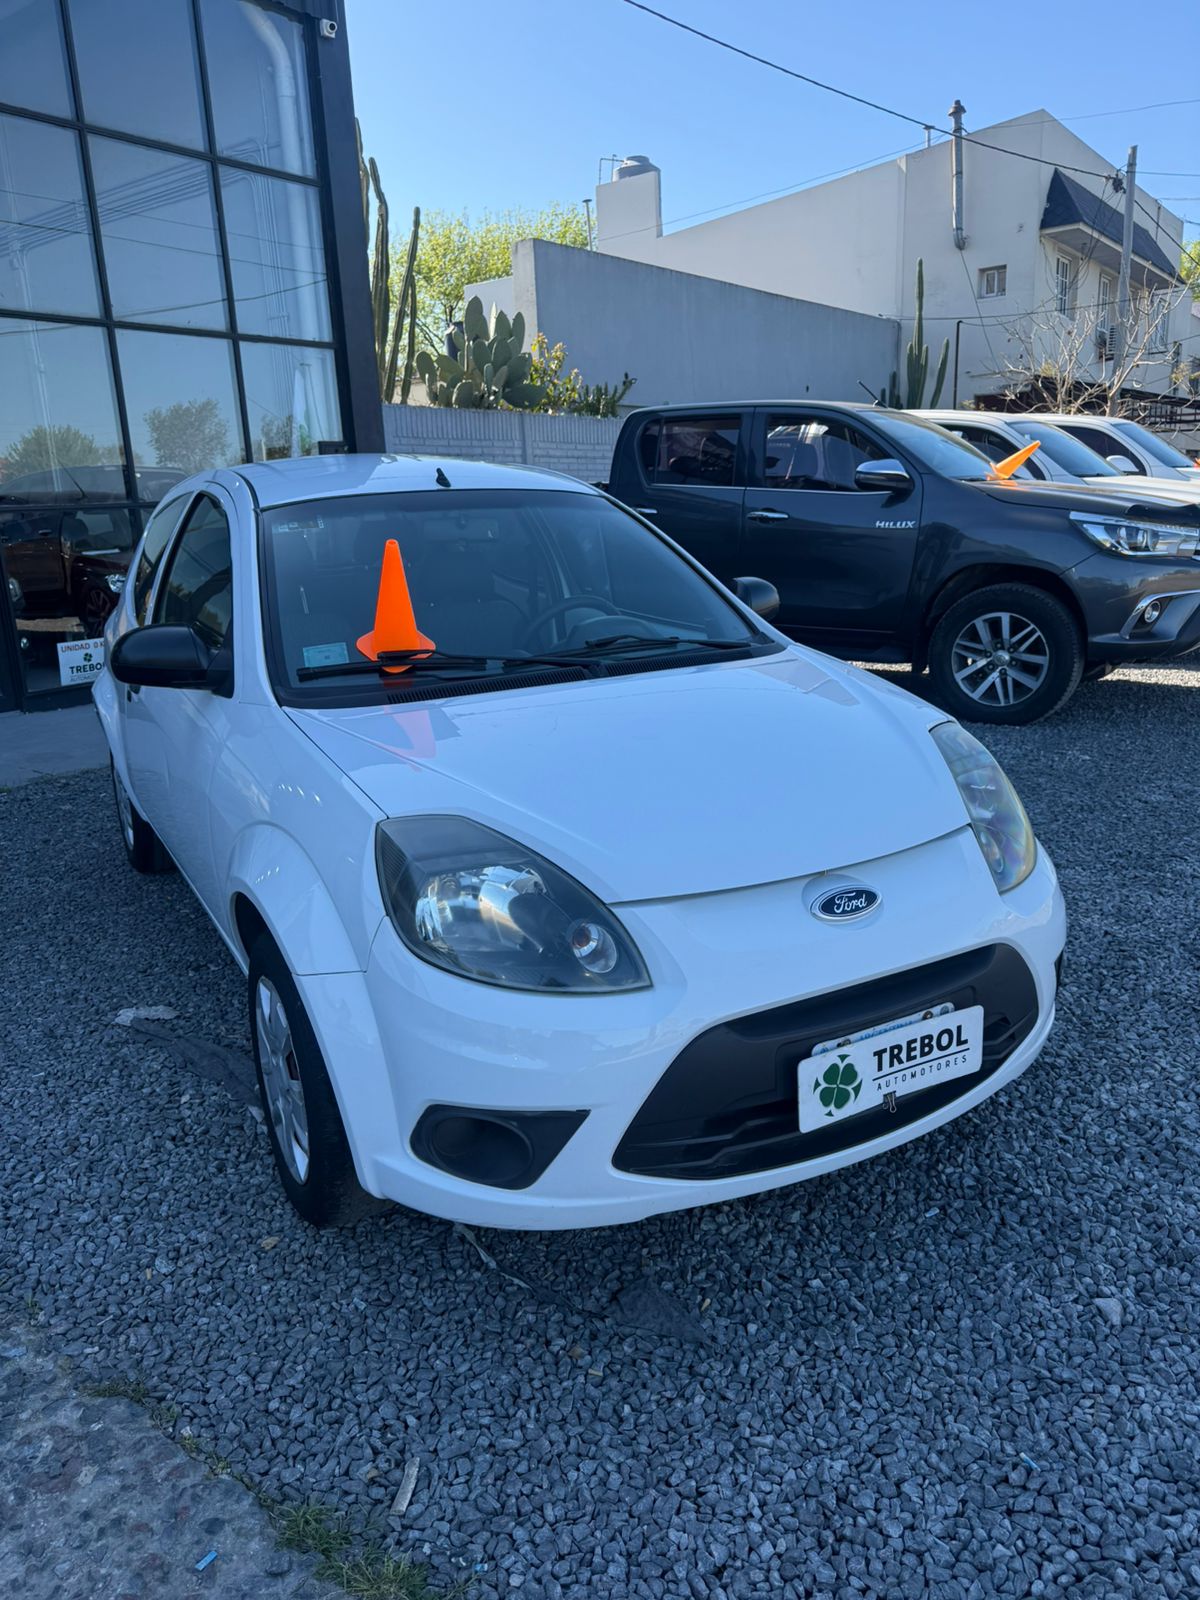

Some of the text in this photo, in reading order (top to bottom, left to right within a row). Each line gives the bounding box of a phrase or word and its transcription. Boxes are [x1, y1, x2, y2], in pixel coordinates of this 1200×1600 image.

[875, 520, 916, 529] HILUX
[61, 642, 91, 653] UNIDAD
[833, 891, 868, 913] Ford
[873, 1024, 969, 1073] TREBOL
[876, 1054, 968, 1092] AUTOMOTORES
